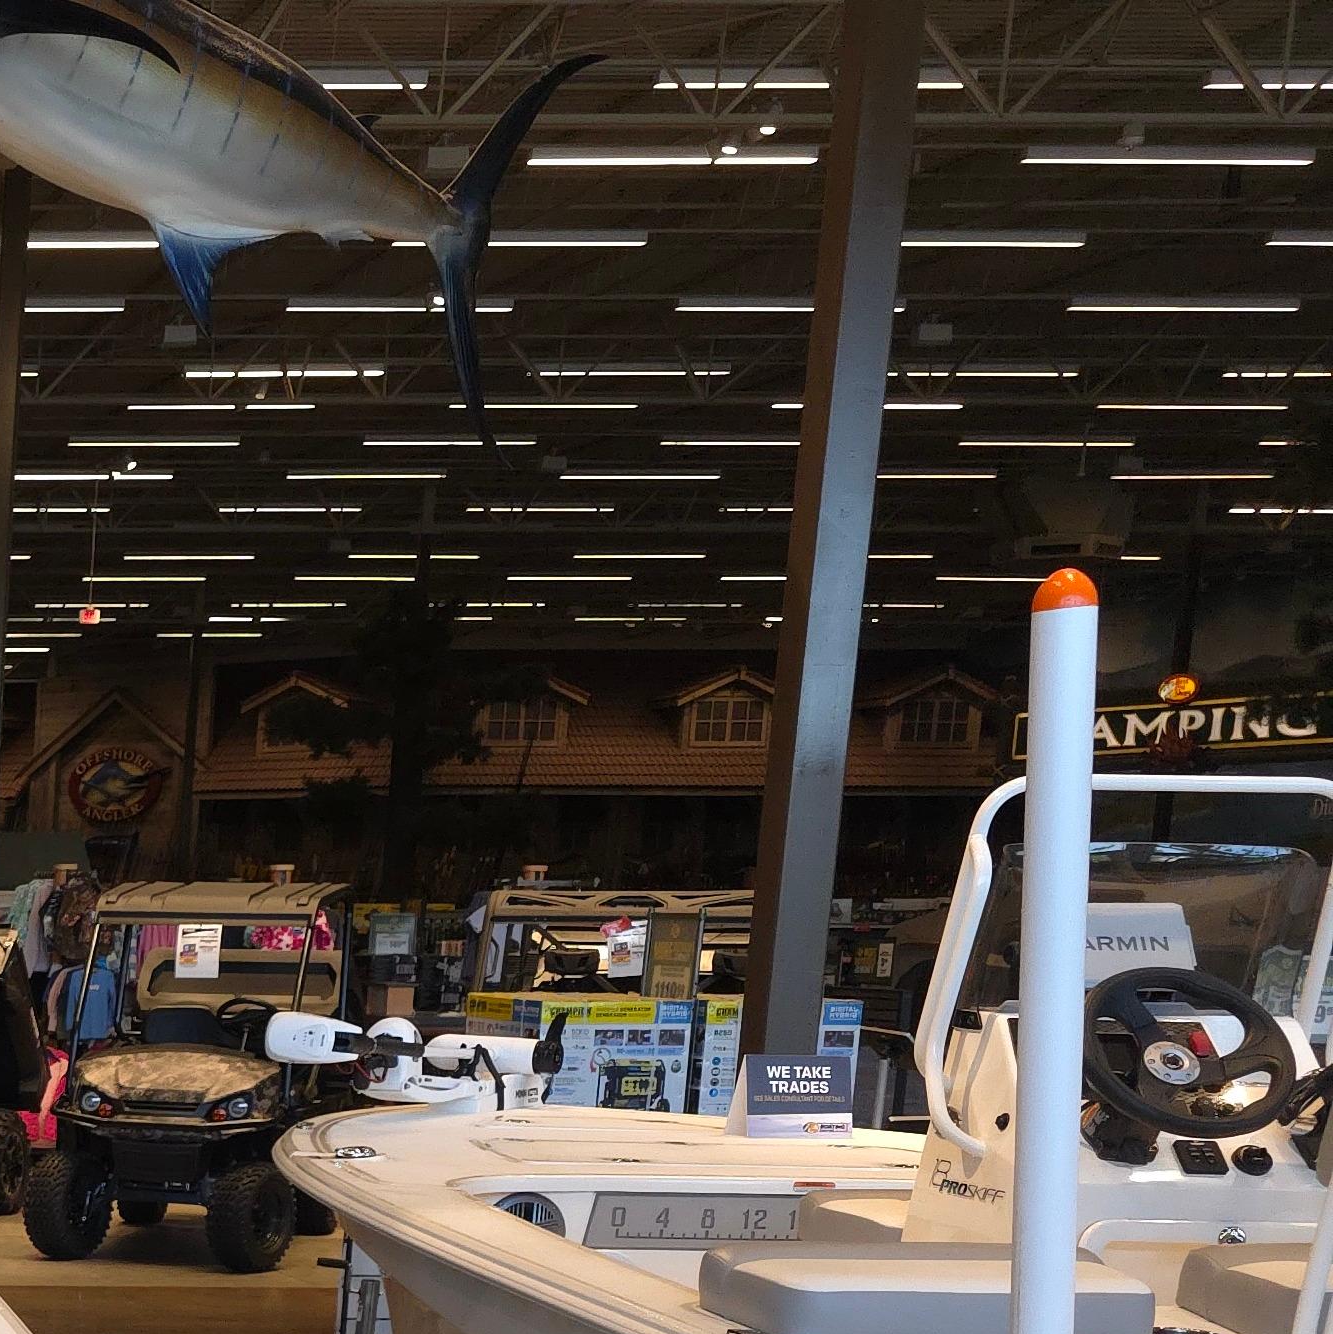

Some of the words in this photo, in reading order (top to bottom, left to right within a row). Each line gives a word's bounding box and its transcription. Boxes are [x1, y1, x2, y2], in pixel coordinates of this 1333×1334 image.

[1093, 705, 1318, 748] AMPING
[75, 748, 154, 775] OFFSHORE
[82, 801, 145, 821] ANGLER
[1085, 936, 1170, 952] ARMIN
[766, 1065, 790, 1079] WE
[792, 1066, 832, 1079] TAKE
[770, 1080, 830, 1094] TRADES
[611, 1206, 626, 1227] 0
[655, 1207, 670, 1228] 4
[700, 1208, 715, 1229] 8
[742, 1209, 768, 1230] 12
